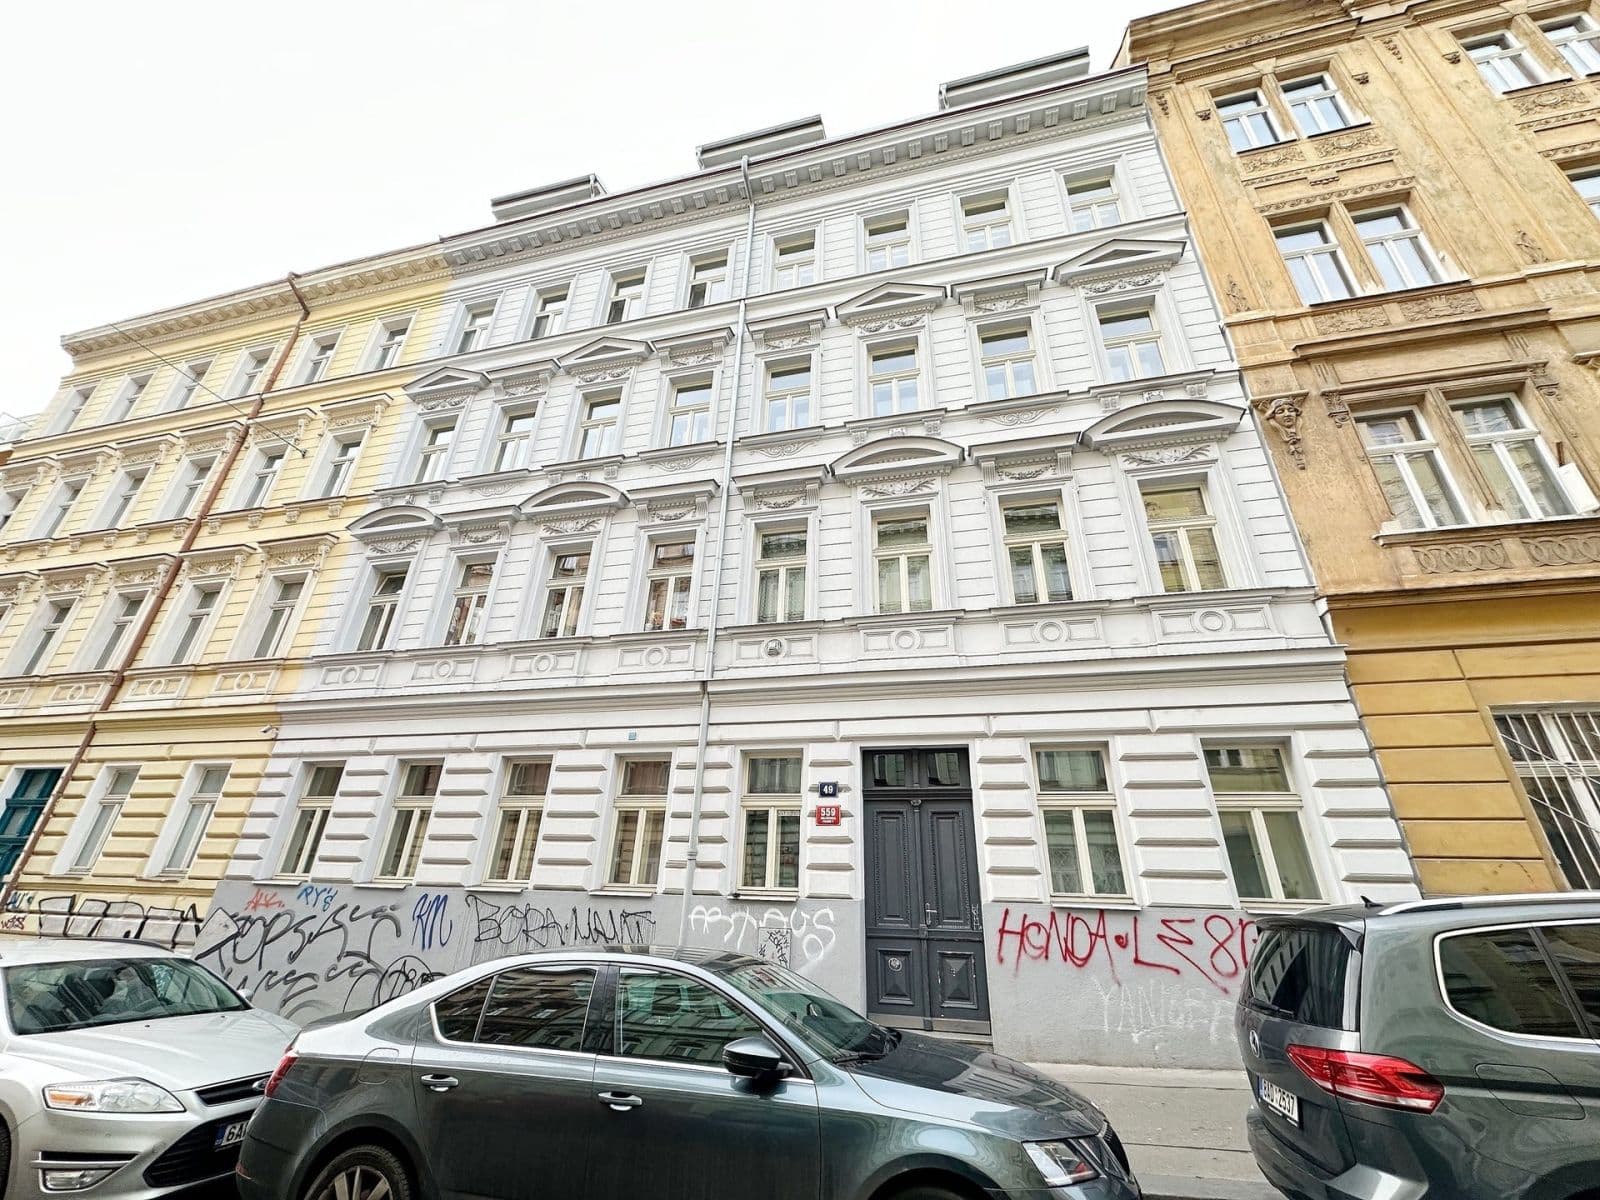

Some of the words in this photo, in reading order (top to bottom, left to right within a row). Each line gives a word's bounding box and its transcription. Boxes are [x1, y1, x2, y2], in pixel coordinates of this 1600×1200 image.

[823, 785, 834, 795] 49
[820, 807, 836, 817] 559
[1279, 1087, 1296, 1116] 2537
